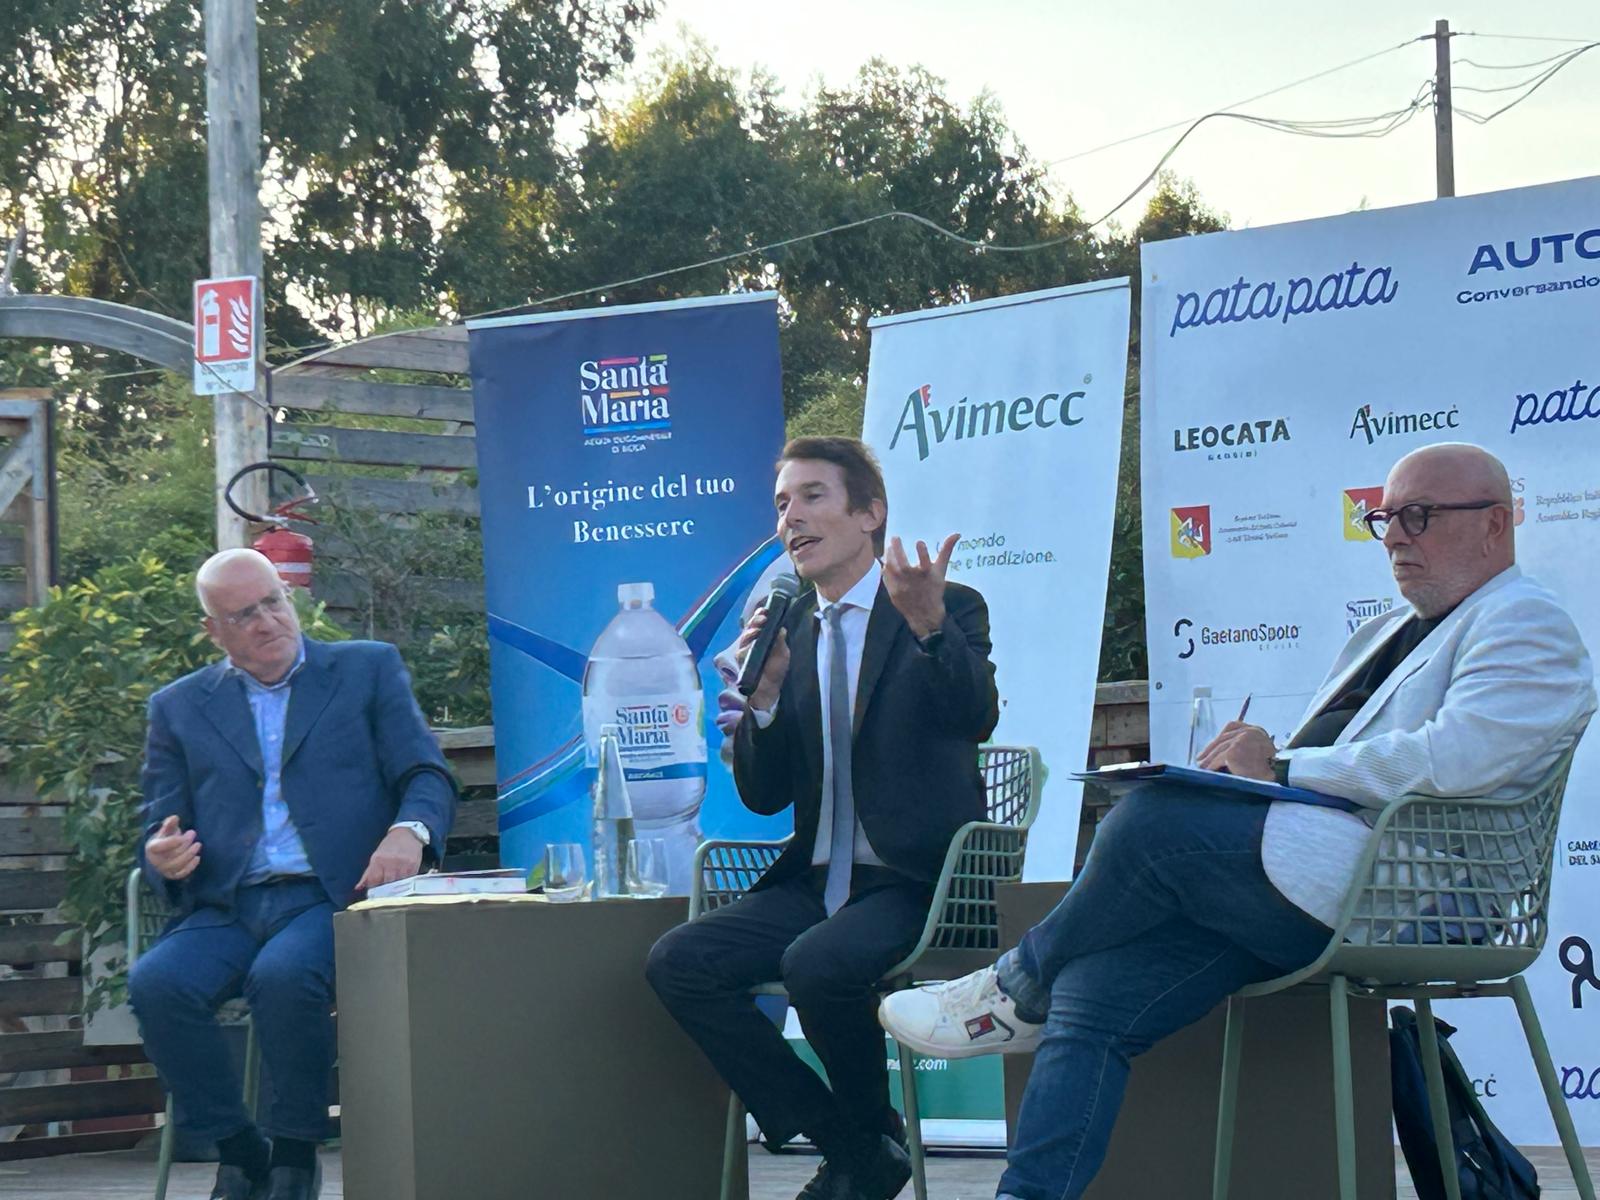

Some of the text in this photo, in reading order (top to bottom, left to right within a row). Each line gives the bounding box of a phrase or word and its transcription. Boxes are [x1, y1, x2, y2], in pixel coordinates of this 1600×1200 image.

[1170, 262, 1399, 337] patapata
[580, 355, 669, 391] Santa
[582, 388, 670, 425] Maria
[889, 383, 1086, 461] Avimecc
[1350, 405, 1460, 445] Avimecc
[1174, 418, 1291, 451] LEOCATA
[527, 474, 735, 511] L'origine del tuo
[573, 518, 695, 543] Benessere
[616, 706, 669, 725] Santa
